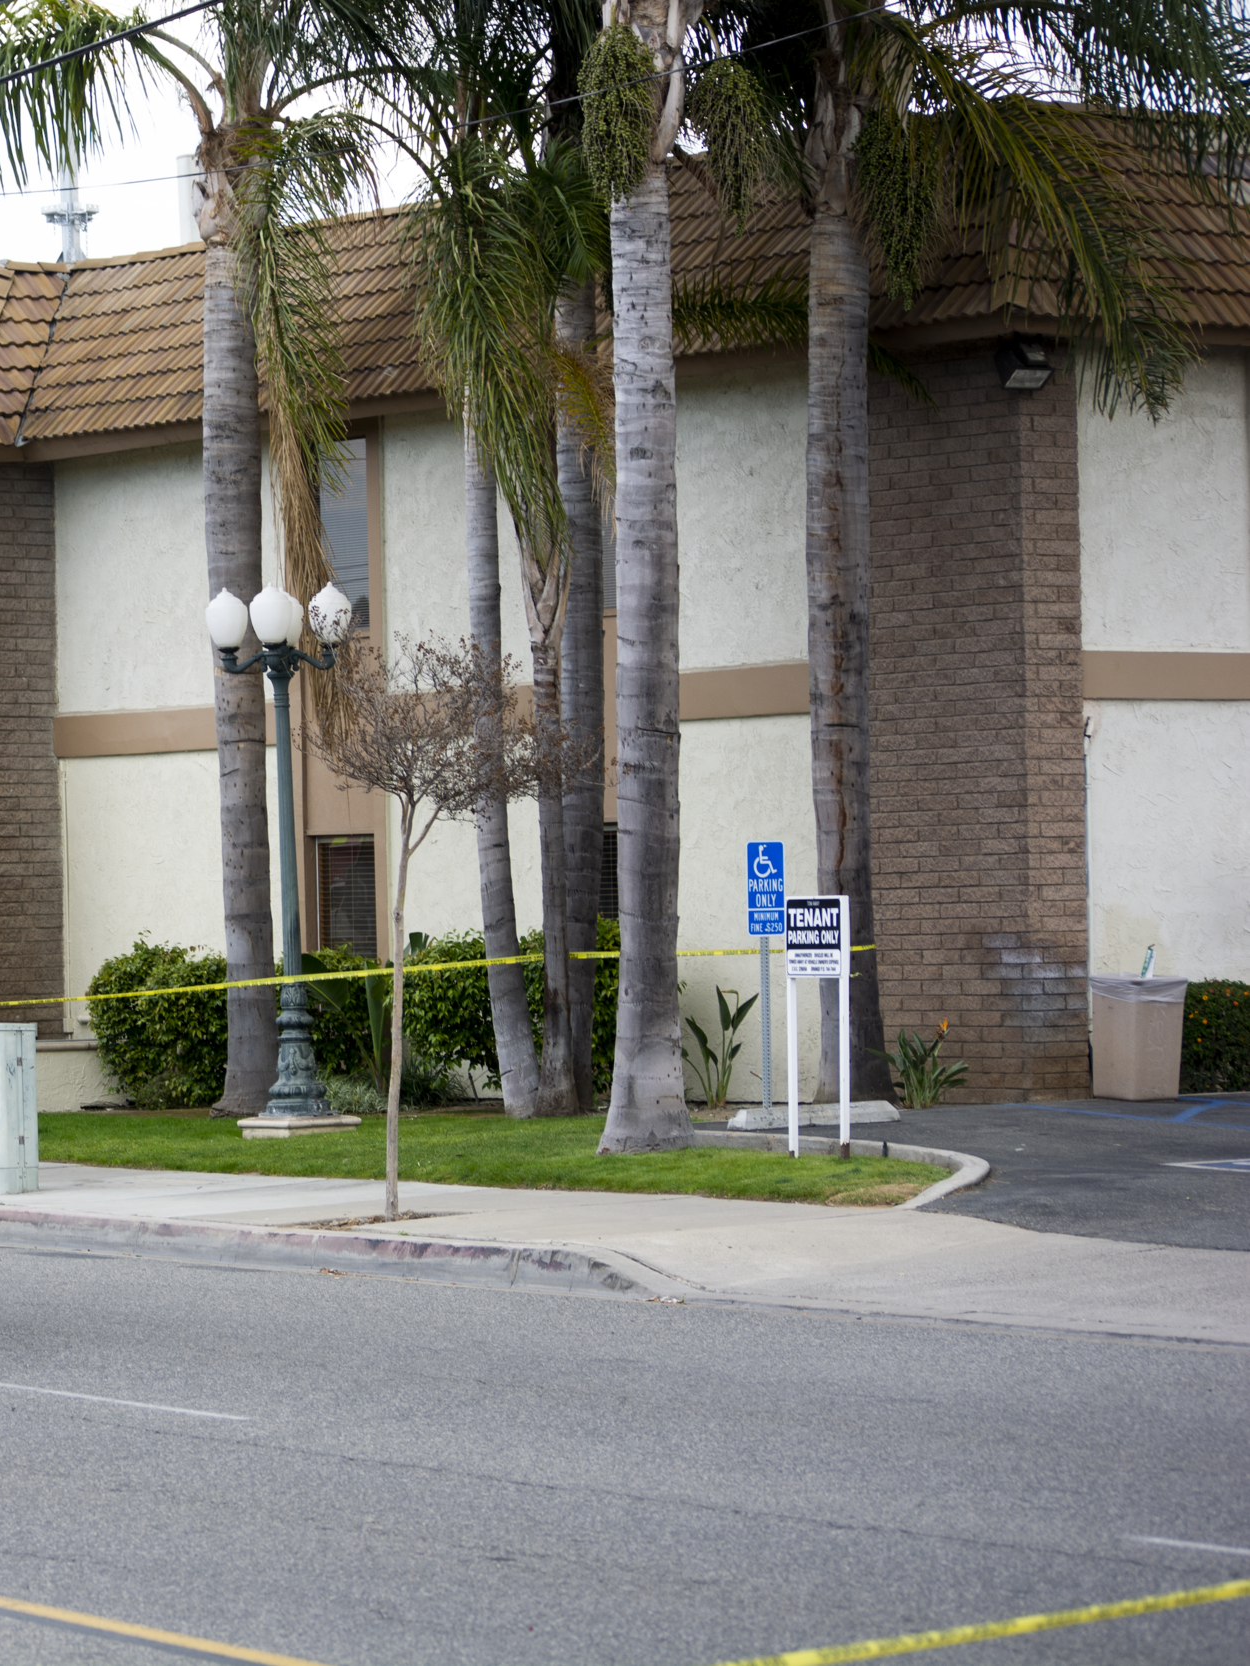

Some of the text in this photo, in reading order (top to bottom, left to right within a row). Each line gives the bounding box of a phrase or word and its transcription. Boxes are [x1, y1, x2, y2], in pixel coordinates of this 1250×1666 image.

[748, 878, 783, 892] PARKING
[755, 893, 777, 907] ONLY
[754, 912, 779, 921] MINIMUM
[788, 908, 839, 927] TENANT
[750, 922, 783, 933] FINE $250
[787, 929, 839, 945] PARKING ONLY
